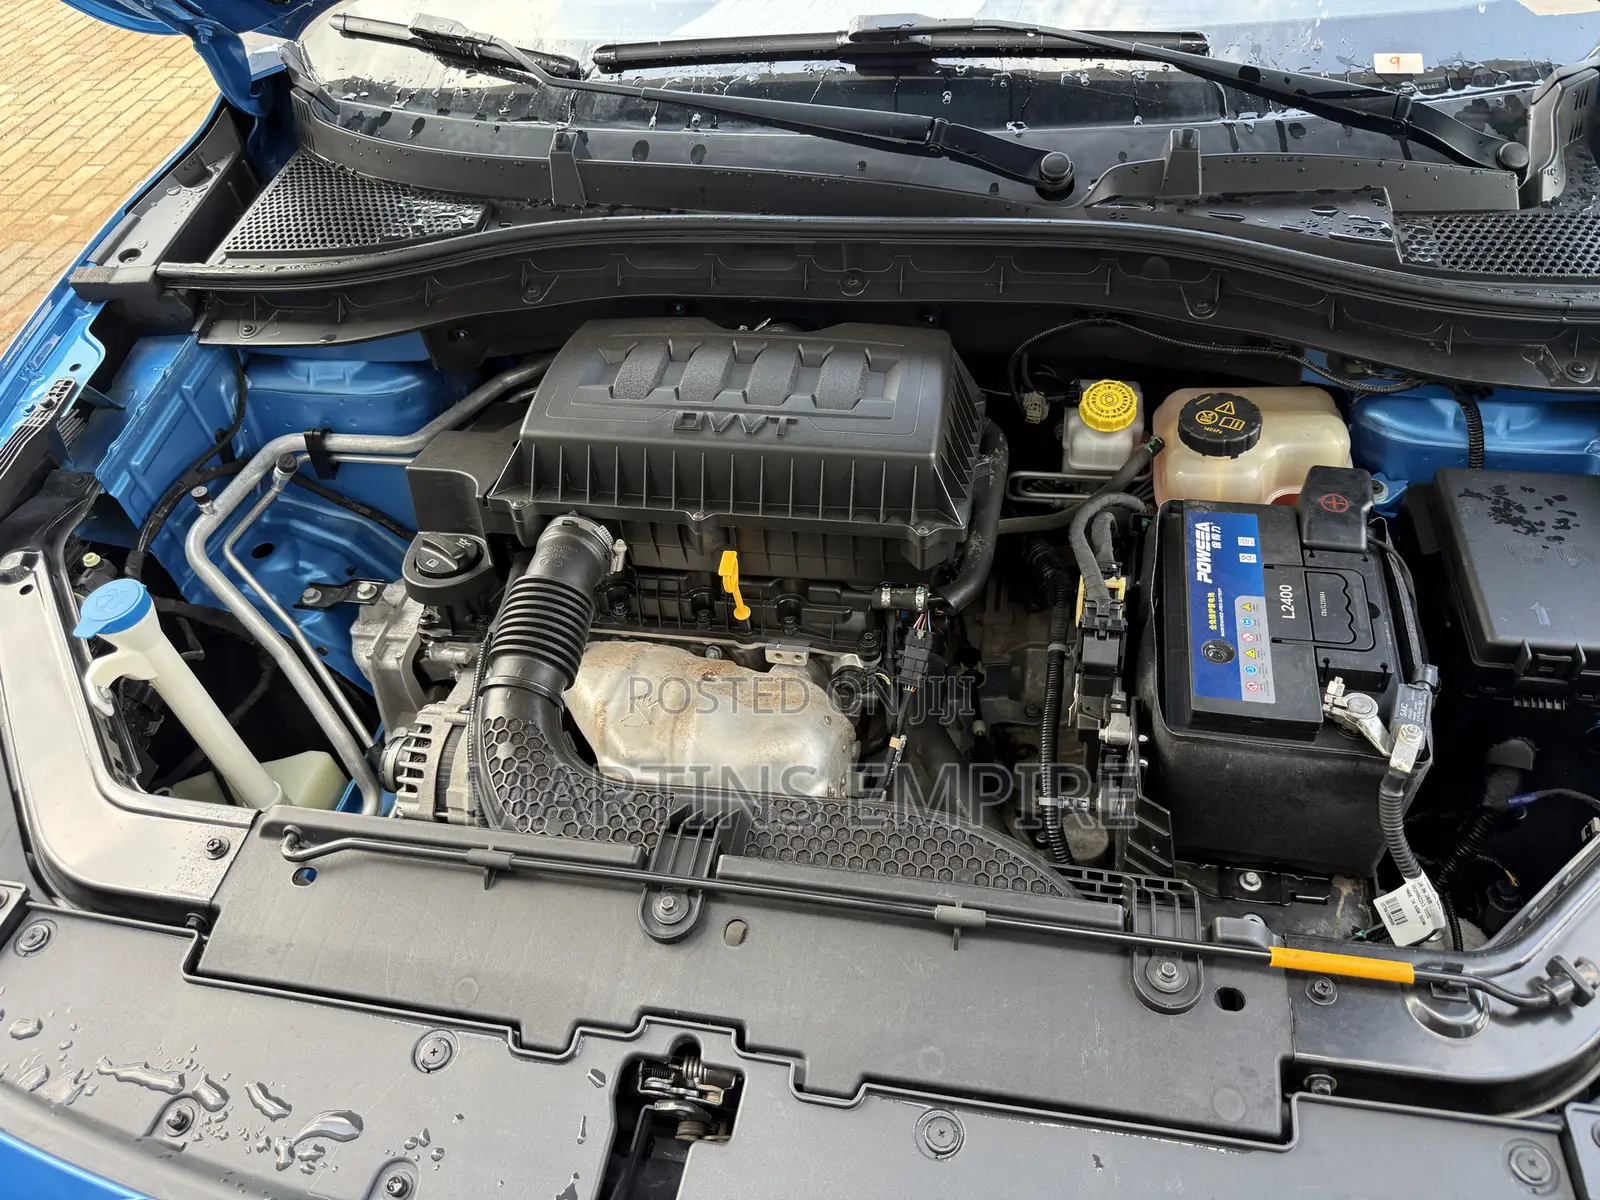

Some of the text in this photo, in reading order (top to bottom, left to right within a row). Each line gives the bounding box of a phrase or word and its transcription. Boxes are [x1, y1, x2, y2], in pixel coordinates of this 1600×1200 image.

[672, 410, 798, 438] DVVT
[1195, 521, 1213, 584] POWSEA
[1279, 584, 1296, 619] L2400
[1400, 702, 1408, 718] SAIC
